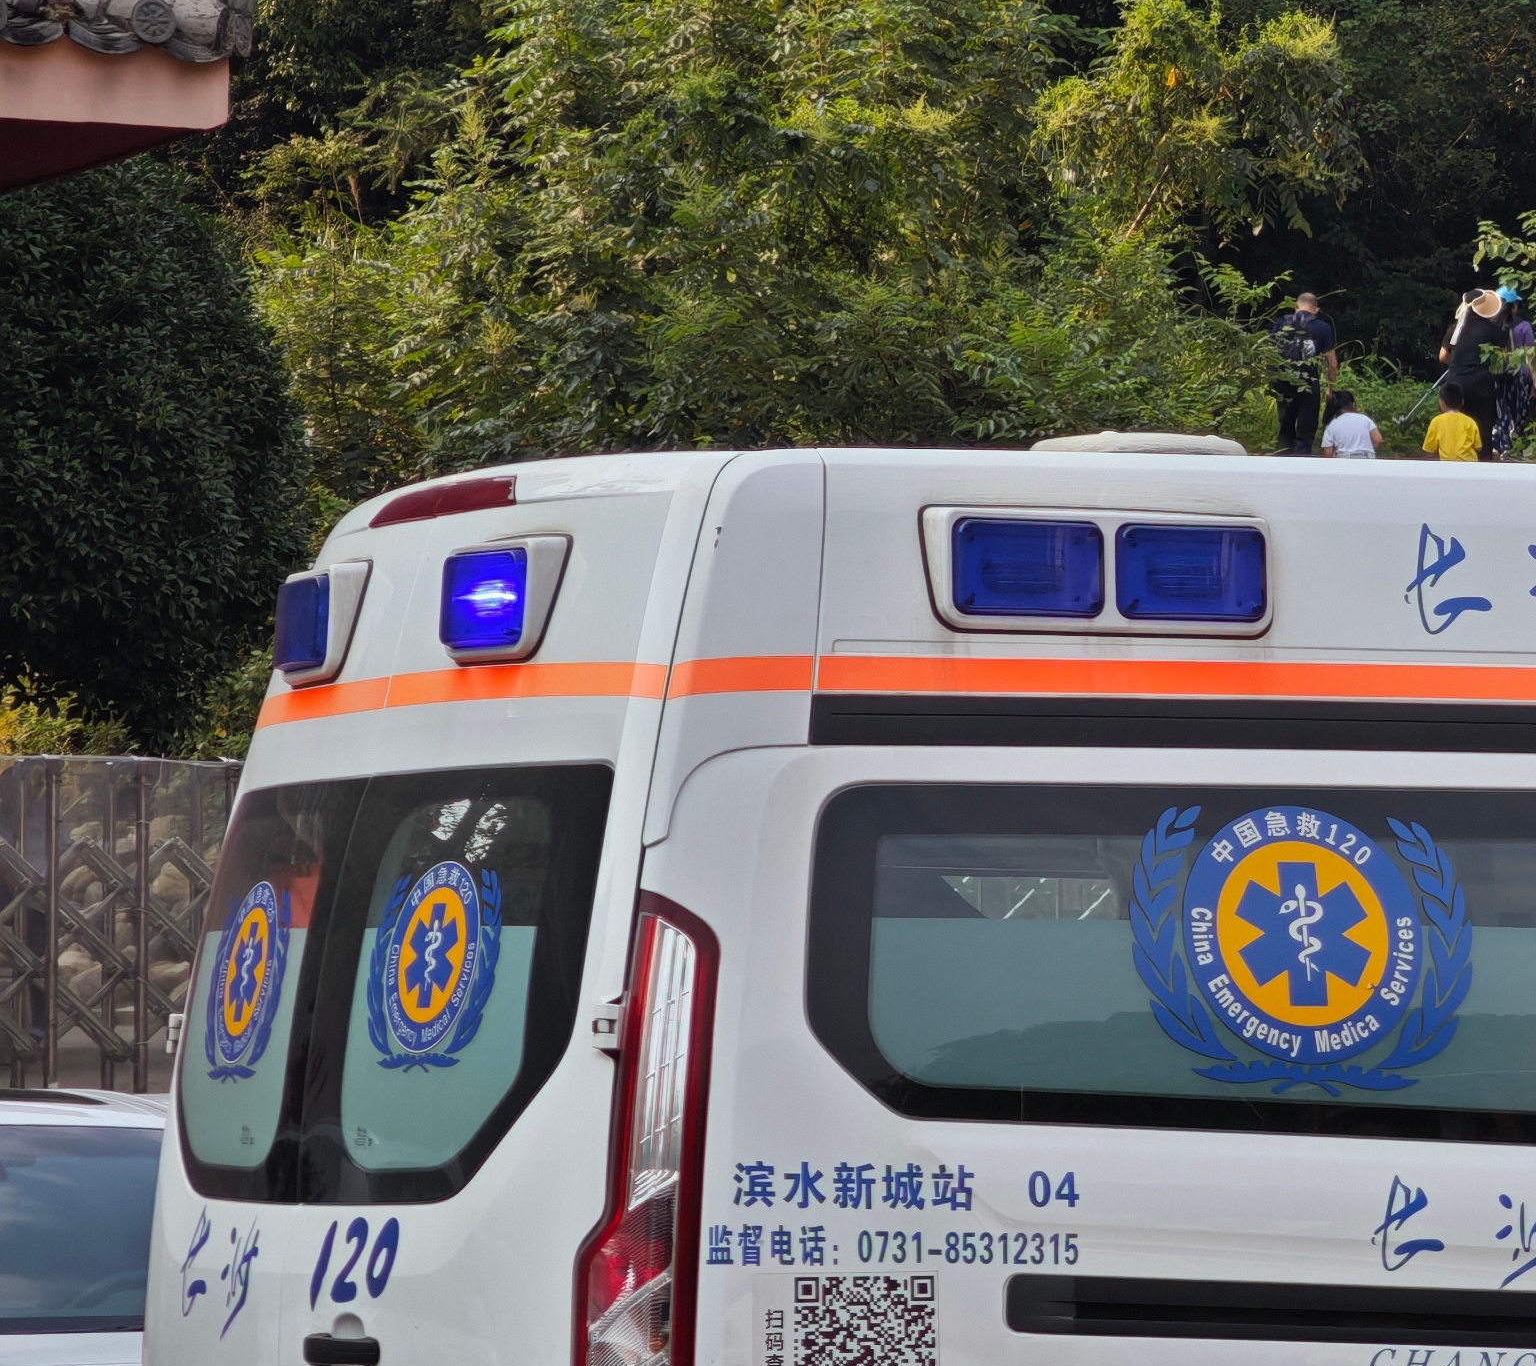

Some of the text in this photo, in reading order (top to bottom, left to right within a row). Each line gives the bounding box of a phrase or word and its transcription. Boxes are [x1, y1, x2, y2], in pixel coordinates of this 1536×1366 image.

[1211, 811, 1372, 865] 中国急救120
[388, 944, 399, 986] China
[451, 942, 476, 1007] Services
[1190, 907, 1213, 966] China
[1207, 974, 1301, 1057] Emergency
[1380, 916, 1414, 1006] Services
[733, 1161, 1080, 1211] 滨水新城站 04
[180, 1204, 399, 1342] 长沙 120
